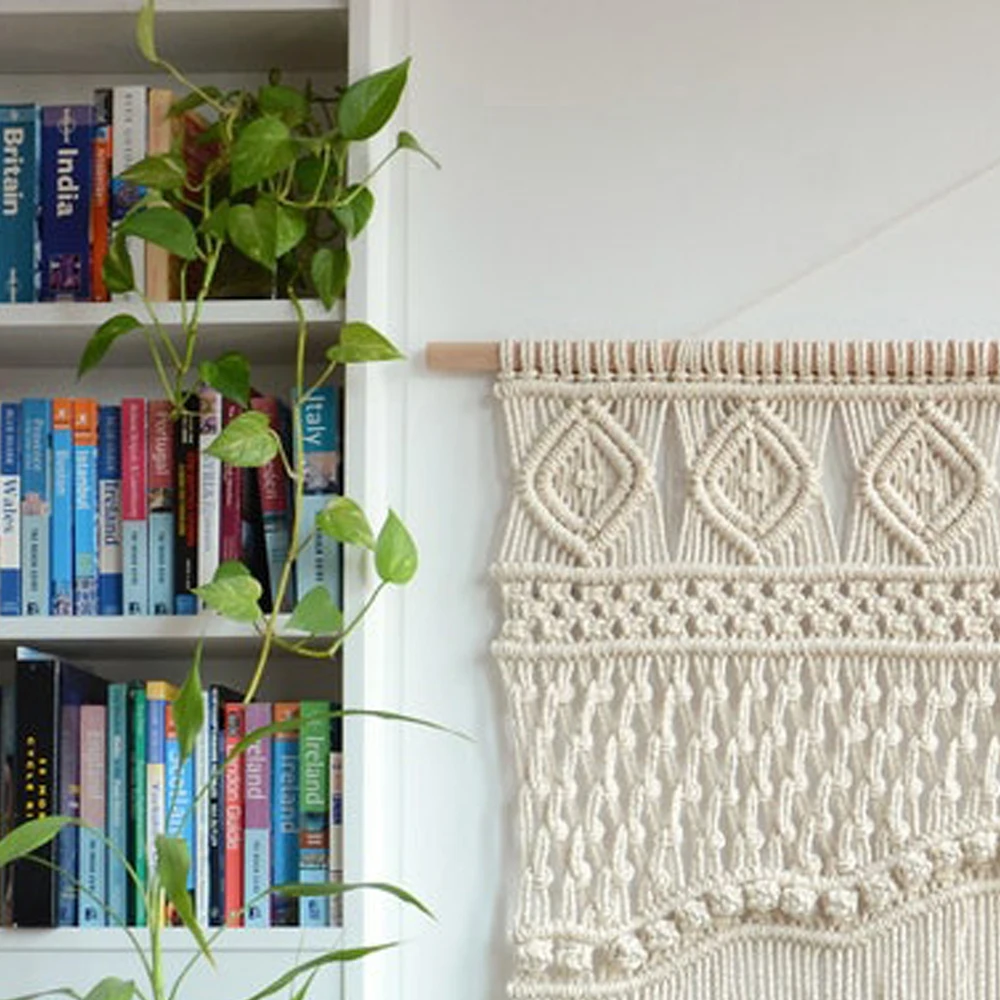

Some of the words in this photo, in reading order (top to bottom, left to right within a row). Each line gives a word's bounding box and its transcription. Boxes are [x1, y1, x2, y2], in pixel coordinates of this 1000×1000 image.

[3, 127, 24, 216] Britain
[56, 147, 80, 218] India
[152, 410, 169, 477] Portugal
[303, 395, 327, 446] Italy
[2, 479, 18, 535] Wales
[104, 480, 119, 546] Ireland
[168, 750, 191, 838] Scotlan
[281, 754, 299, 834] Ireland
[304, 735, 324, 805] Ireland
[226, 804, 241, 850] Guide
